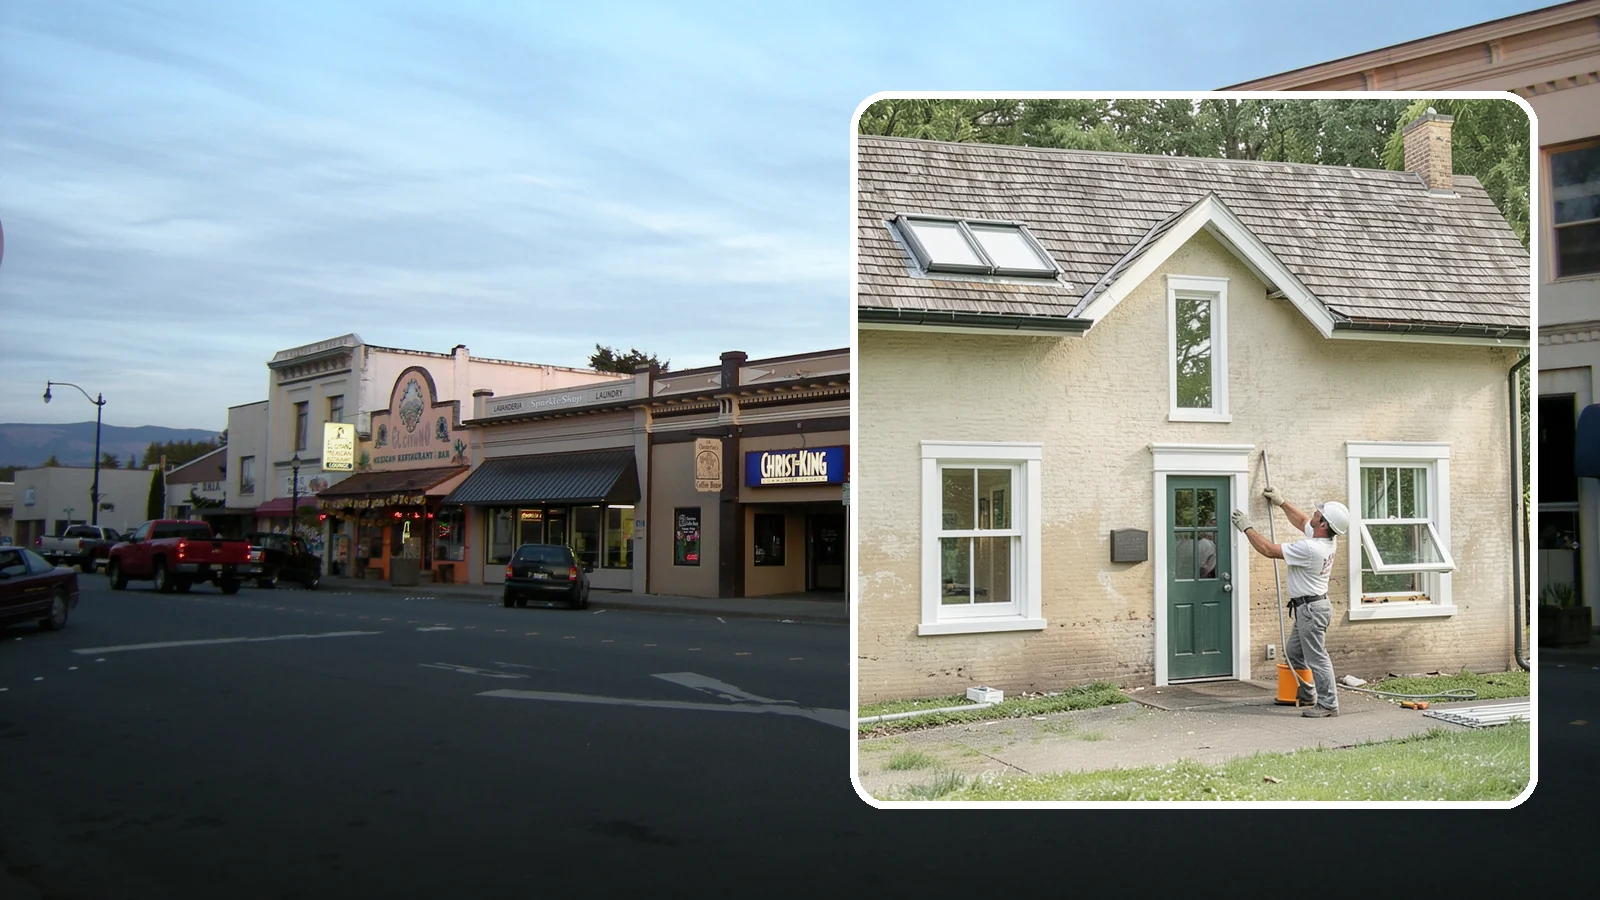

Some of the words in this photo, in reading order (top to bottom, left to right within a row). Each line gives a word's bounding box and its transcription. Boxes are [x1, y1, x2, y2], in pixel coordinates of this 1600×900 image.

[493, 402, 522, 413] LAVANDERIA
[531, 395, 561, 409] Sparkle
[562, 393, 582, 405] Shop
[595, 388, 623, 400] LAUNDRY
[373, 455, 396, 464] MEXICAN
[397, 451, 433, 462] RESTAURANT
[438, 450, 450, 459] BAR
[761, 452, 797, 478] CHRIST
[799, 450, 827, 476] KING
